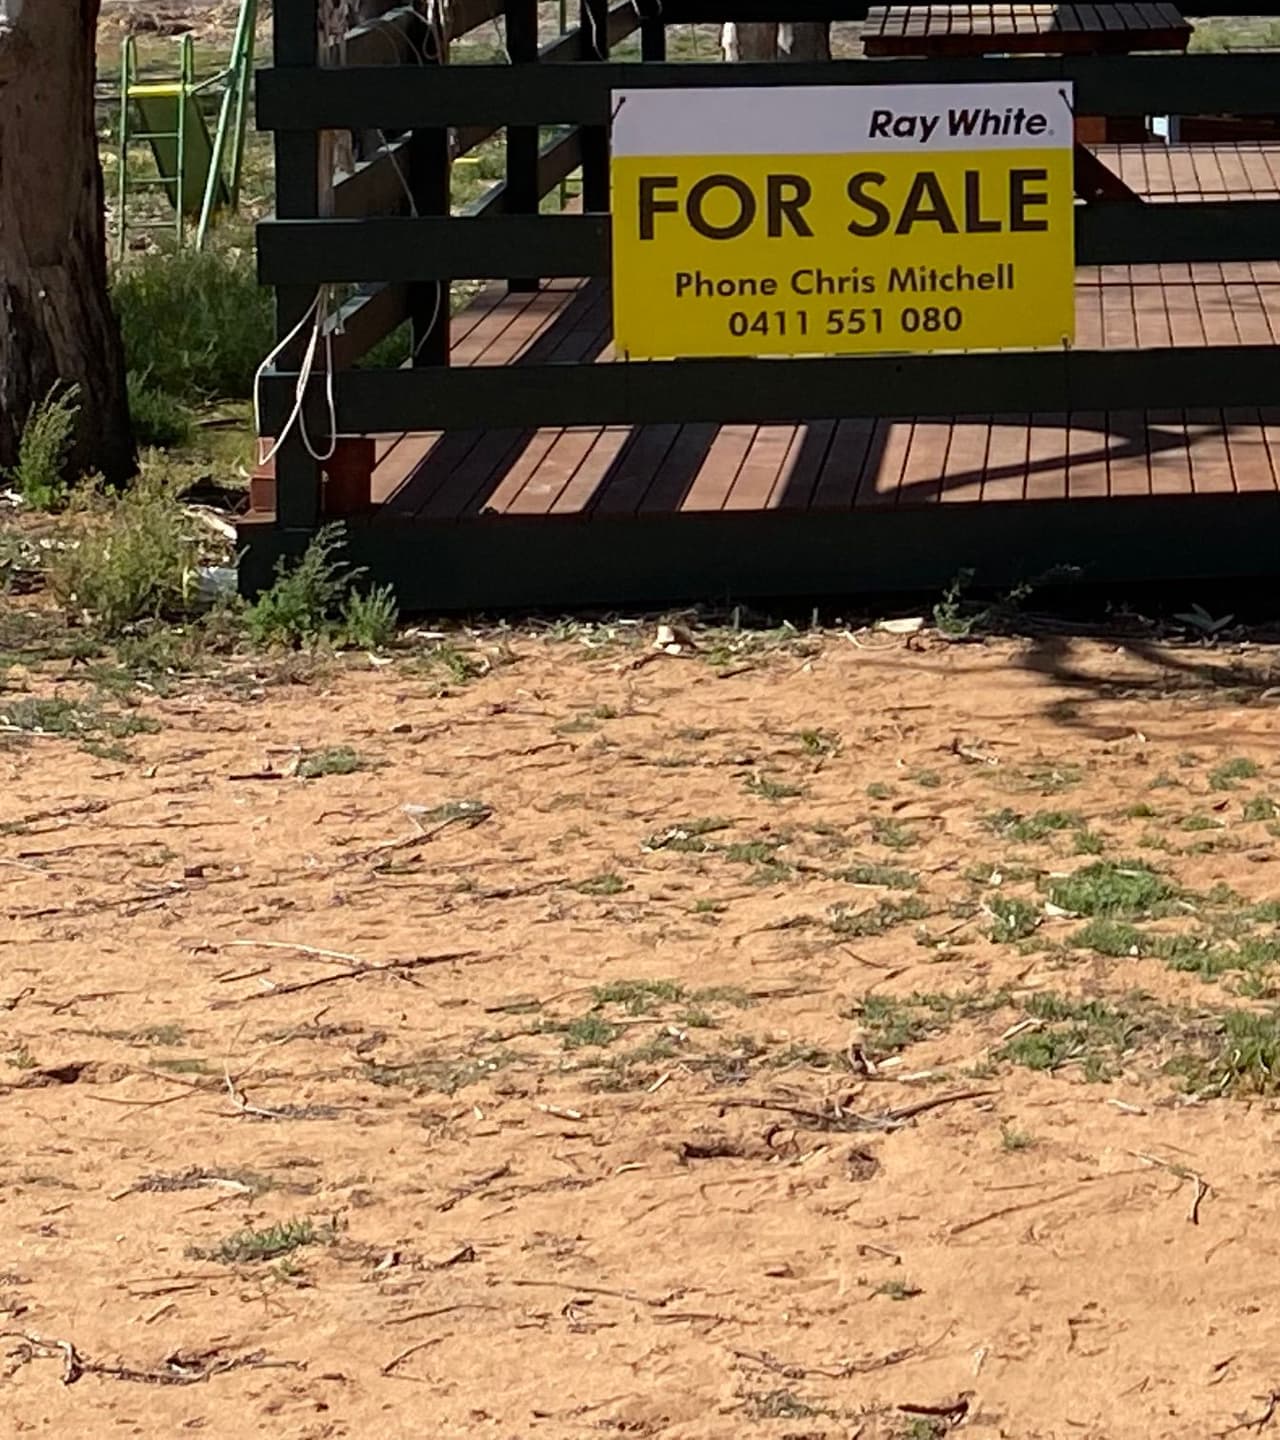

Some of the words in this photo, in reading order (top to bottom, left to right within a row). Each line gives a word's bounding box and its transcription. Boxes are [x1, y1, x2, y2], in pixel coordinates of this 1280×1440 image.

[868, 109, 940, 142] Ray
[638, 174, 814, 240] FOR
[847, 169, 1048, 237] SALE
[676, 271, 777, 297] Phone
[791, 268, 875, 294] Chris
[888, 263, 1014, 292] Mitchell
[729, 310, 807, 336] 0411
[826, 308, 882, 334] 551
[901, 306, 963, 332] 080
